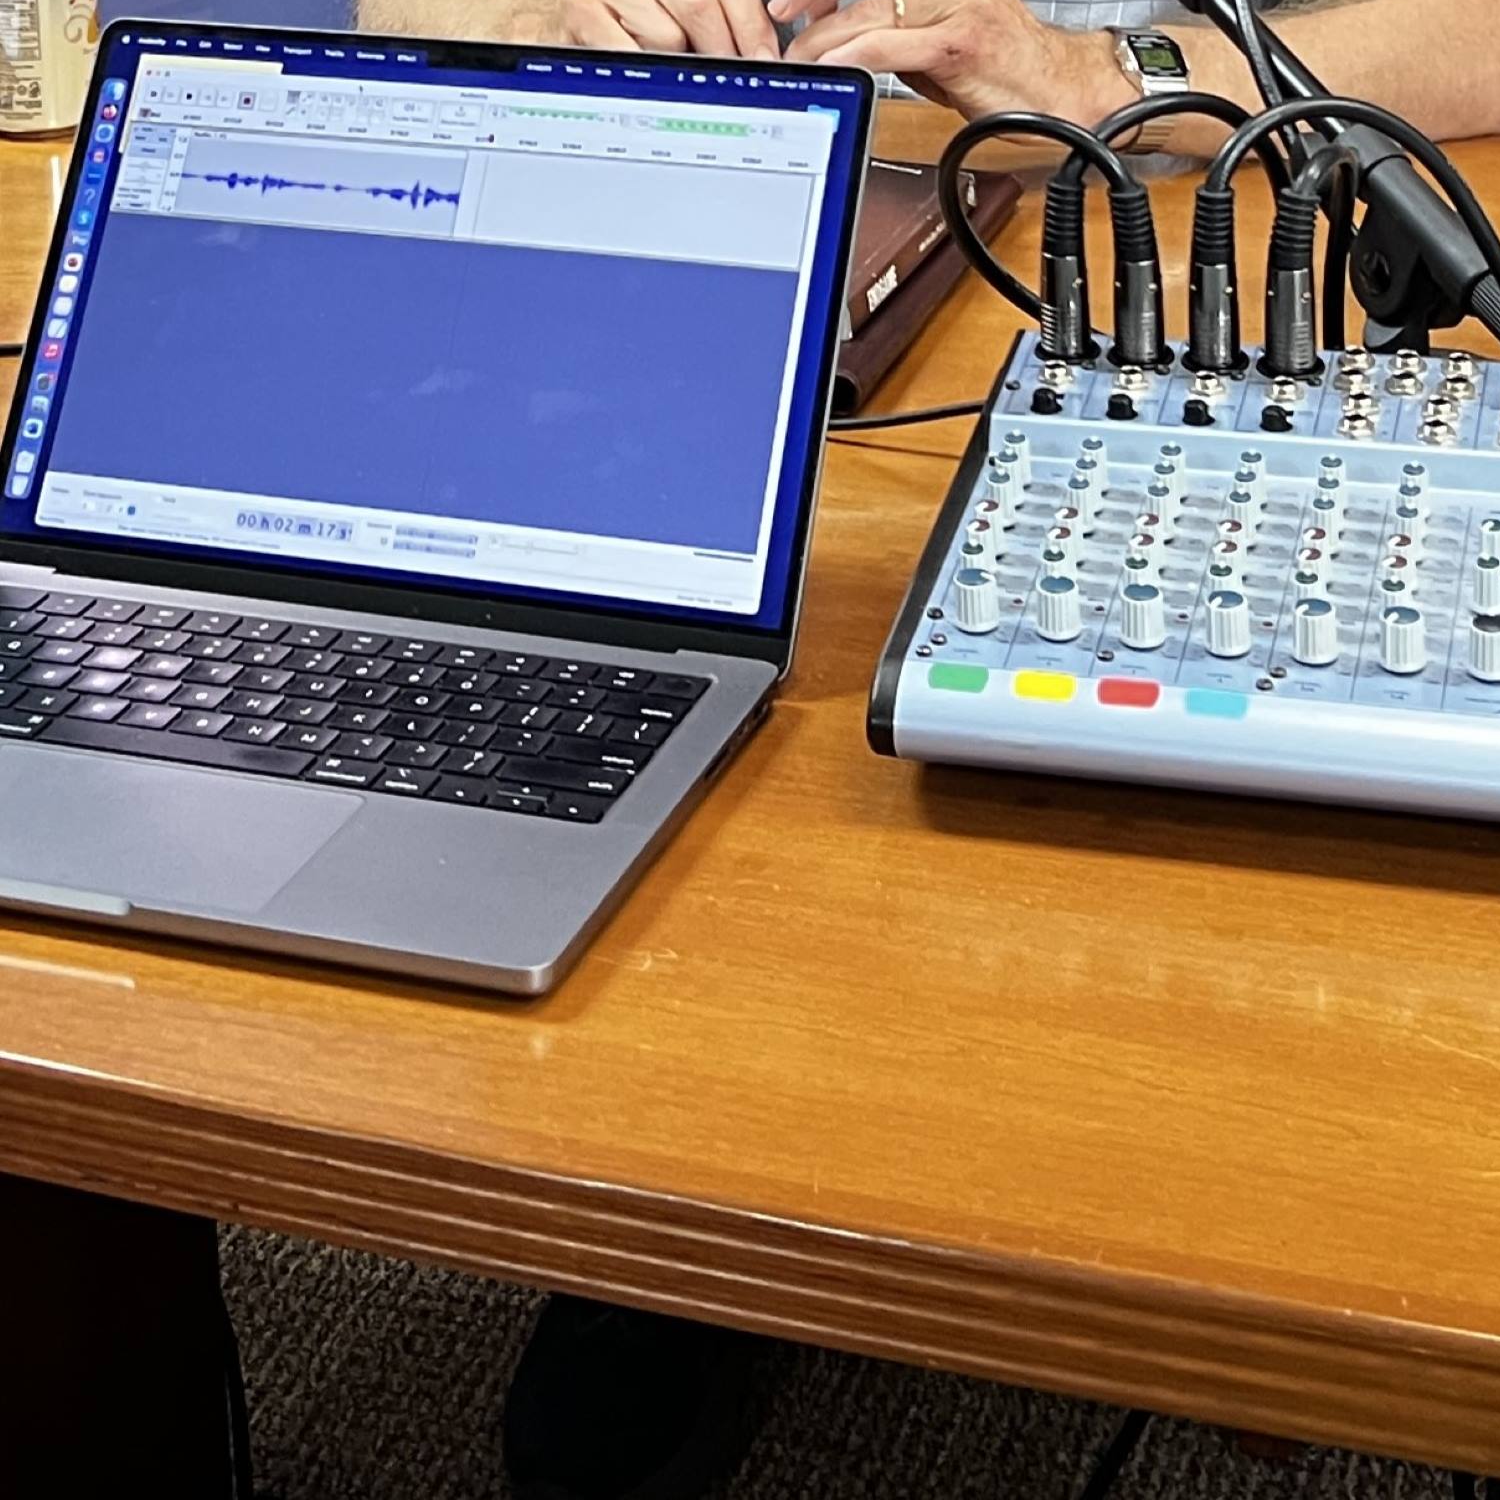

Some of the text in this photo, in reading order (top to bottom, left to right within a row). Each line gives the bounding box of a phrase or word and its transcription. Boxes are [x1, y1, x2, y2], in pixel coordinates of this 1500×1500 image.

[237, 512, 257, 528] 00
[260, 516, 270, 530] h
[274, 518, 293, 532] 02
[298, 523, 311, 533] m
[318, 522, 336, 537] 17
